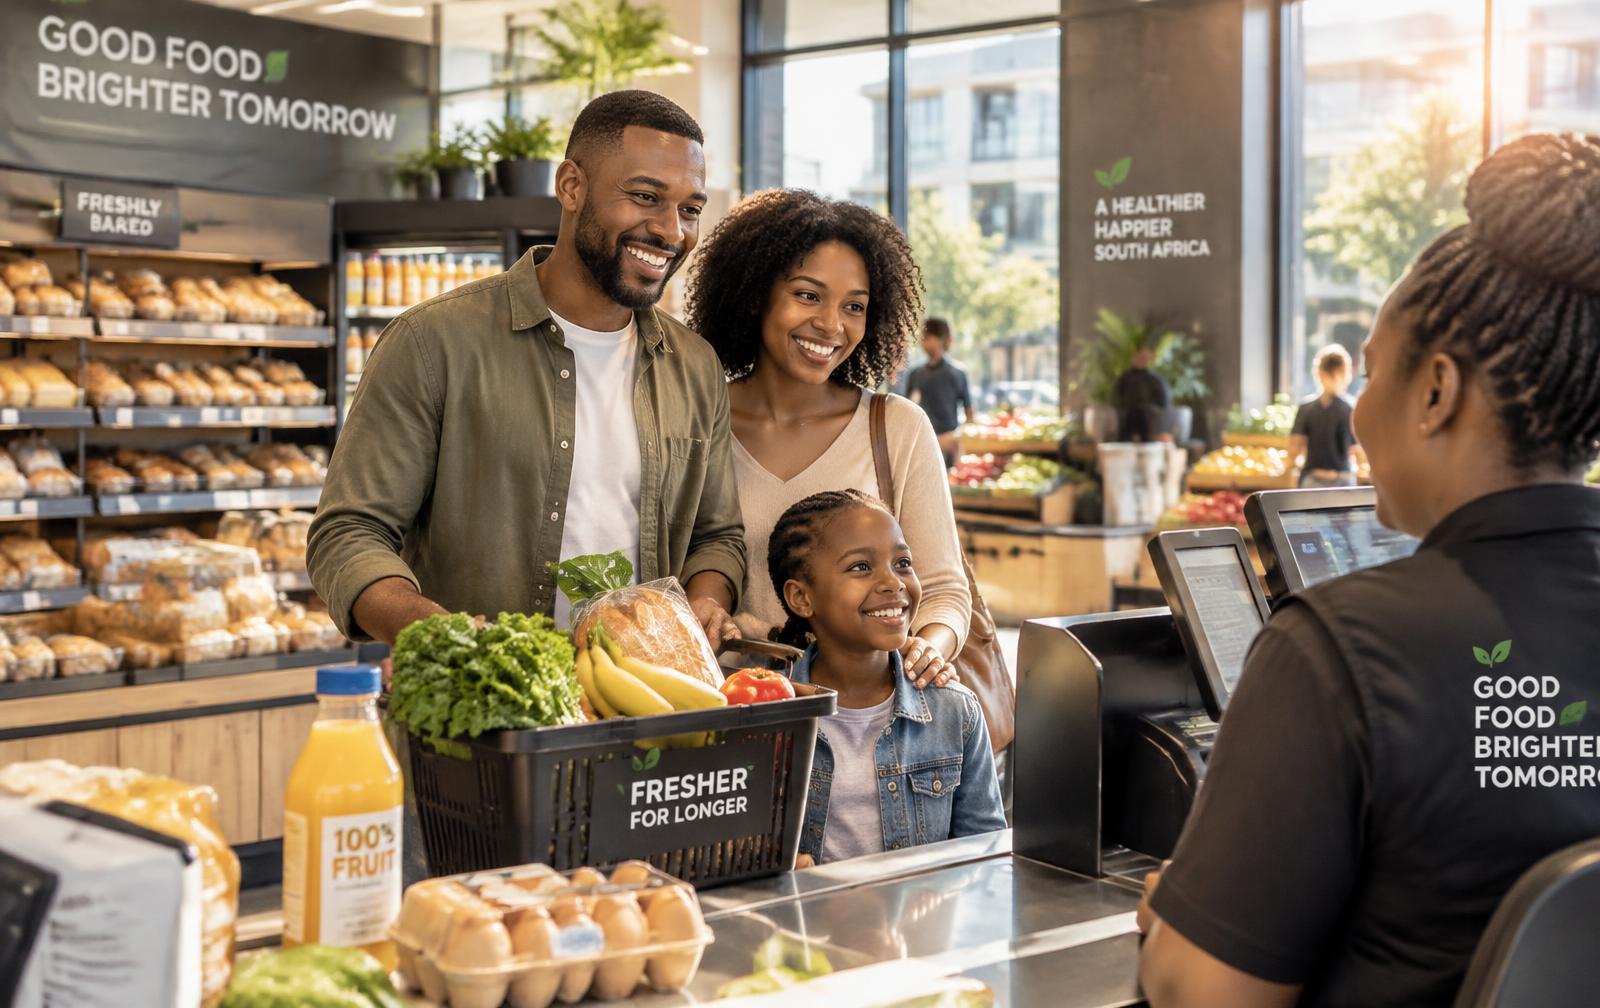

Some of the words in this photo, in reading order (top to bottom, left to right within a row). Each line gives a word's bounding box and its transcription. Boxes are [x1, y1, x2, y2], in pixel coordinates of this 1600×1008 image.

[38, 15, 156, 65] GOOD
[165, 36, 262, 82] FOOD
[38, 62, 211, 119] BRIGHTER
[219, 88, 397, 141] TOMORROW
[78, 192, 162, 218] FRESHLY
[1094, 198, 1109, 216] A
[1112, 192, 1206, 215] HEALTHIER
[1094, 218, 1173, 240] HAPPIER
[1094, 242, 1149, 261] SOUTH
[1151, 239, 1211, 258] AFRICA
[1473, 675, 1560, 699] GOOD
[1475, 705, 1556, 729] FOOD
[1474, 735, 1600, 758] BRIGHTE
[630, 767, 748, 806] FRESHER
[1474, 765, 1600, 788] TOMORR
[630, 808, 669, 830] FOR
[674, 796, 748, 823] LONGER
[332, 848, 396, 880] FRUIT
